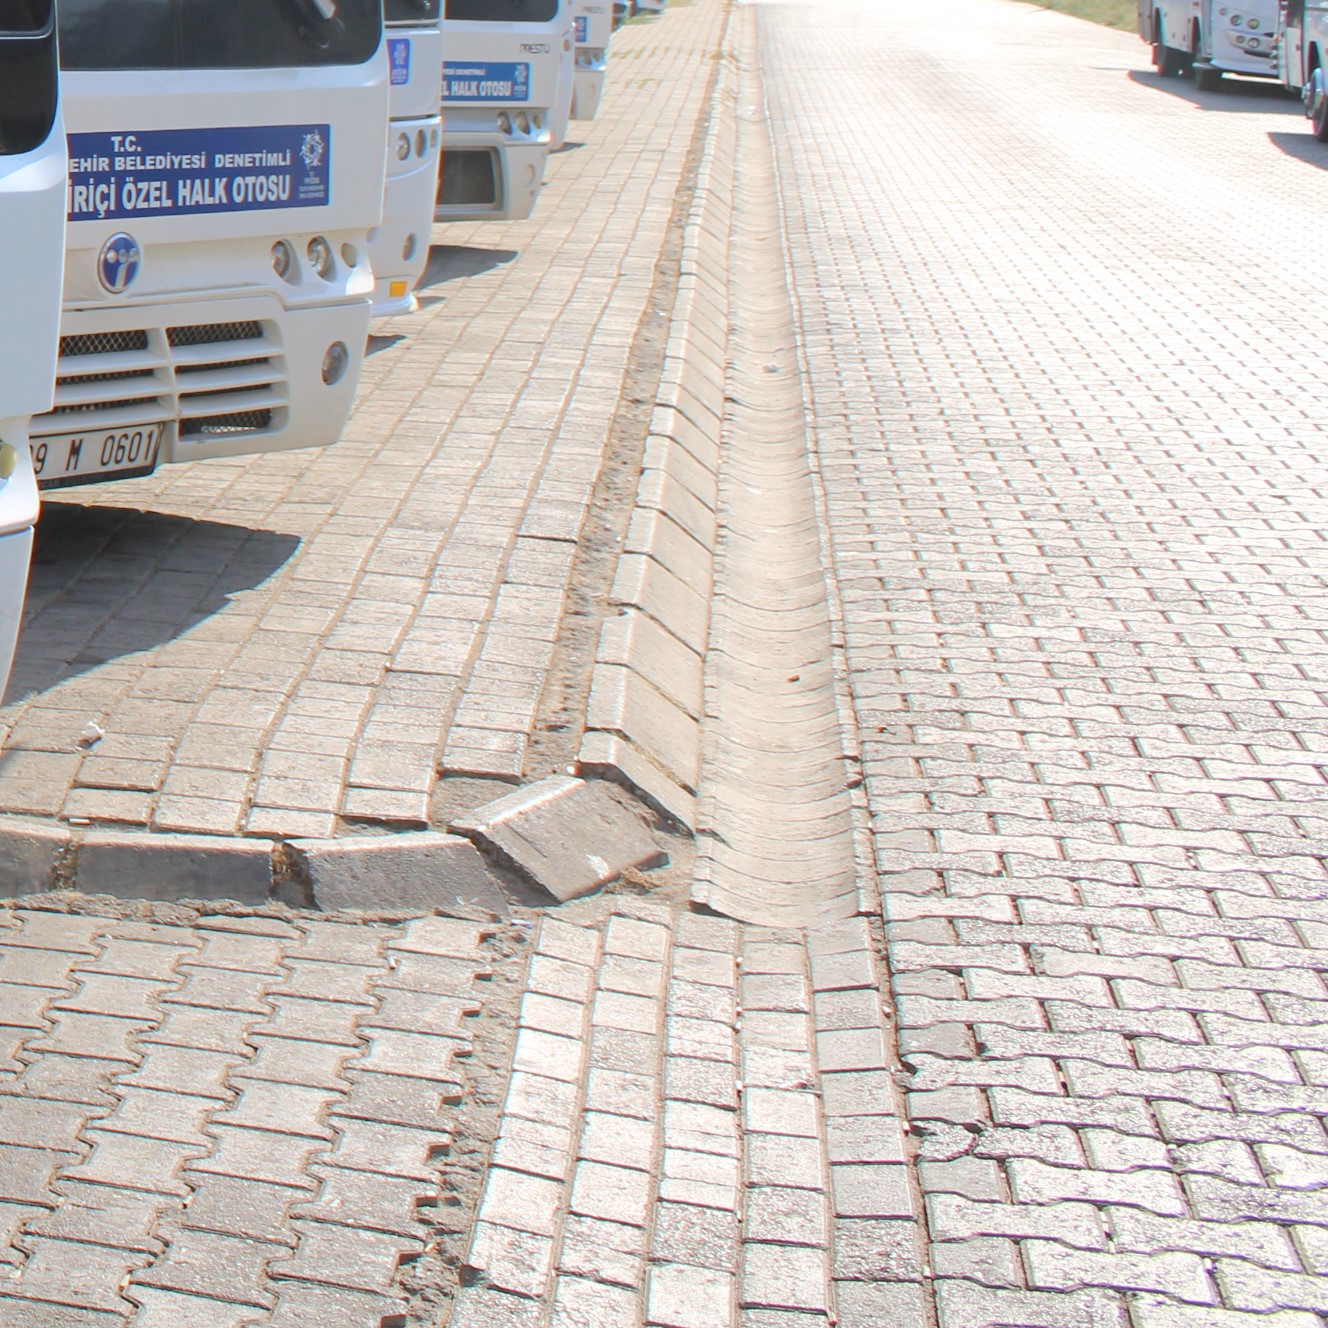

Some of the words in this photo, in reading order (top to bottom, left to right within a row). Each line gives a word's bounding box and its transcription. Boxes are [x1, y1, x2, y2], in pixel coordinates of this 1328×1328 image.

[451, 80, 479, 96] HALK
[479, 80, 513, 96] OTOSU
[111, 135, 142, 153] T.C.
[114, 152, 206, 172] BELEDİYESİ
[214, 149, 291, 168] DENETİMLİ
[122, 176, 173, 211] ÖZEL
[177, 177, 229, 207] HALK
[232, 174, 291, 204] OTOSU
[65, 438, 84, 471] M
[100, 430, 154, 467] 0601
